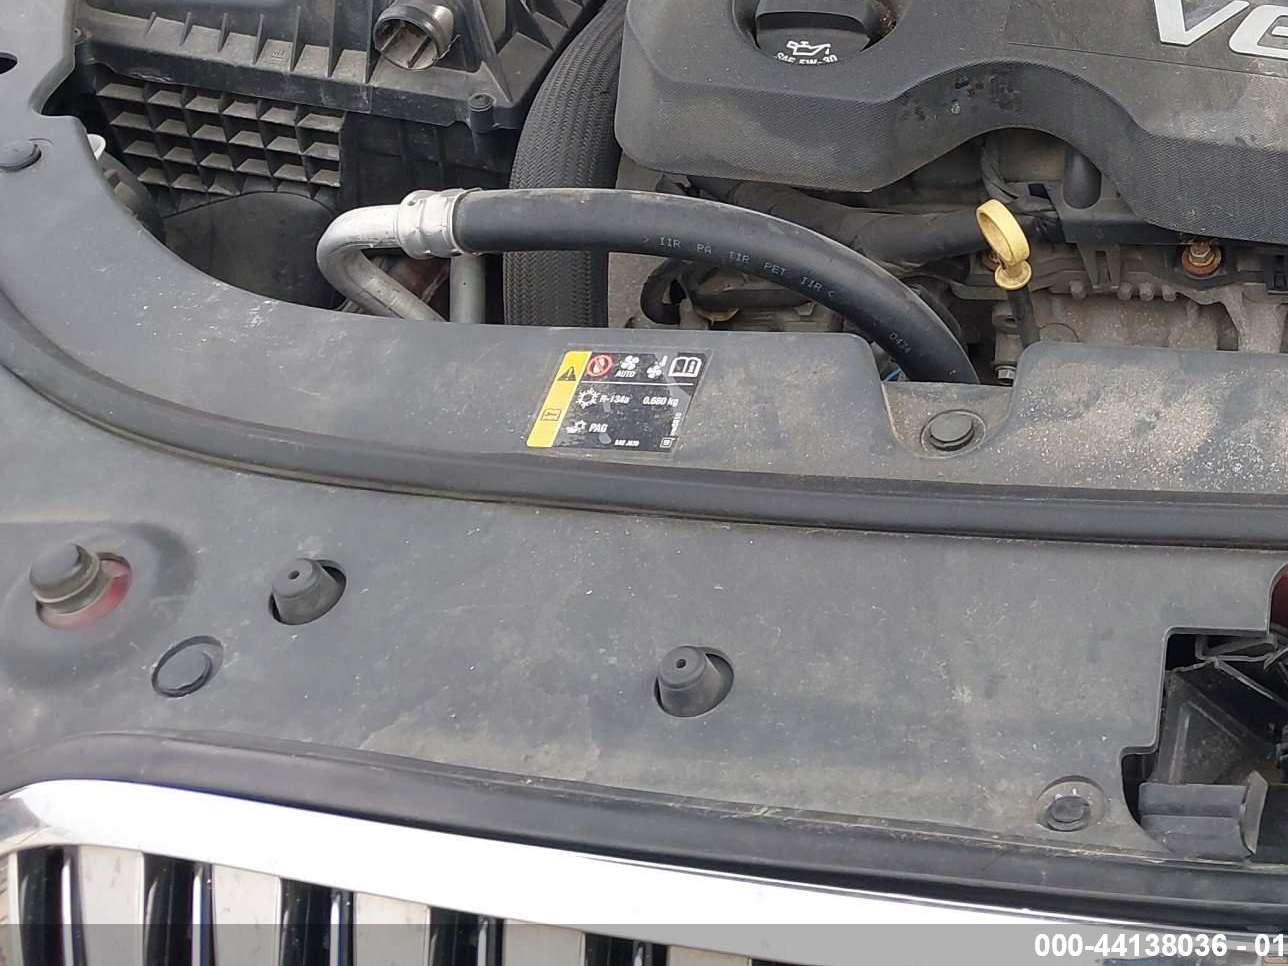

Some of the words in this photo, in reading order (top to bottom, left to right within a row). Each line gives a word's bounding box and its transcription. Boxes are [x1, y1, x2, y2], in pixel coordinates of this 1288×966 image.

[696, 243, 713, 255] PA
[763, 261, 788, 277] PET
[615, 370, 636, 378] AUTO
[588, 422, 608, 433] PAG
